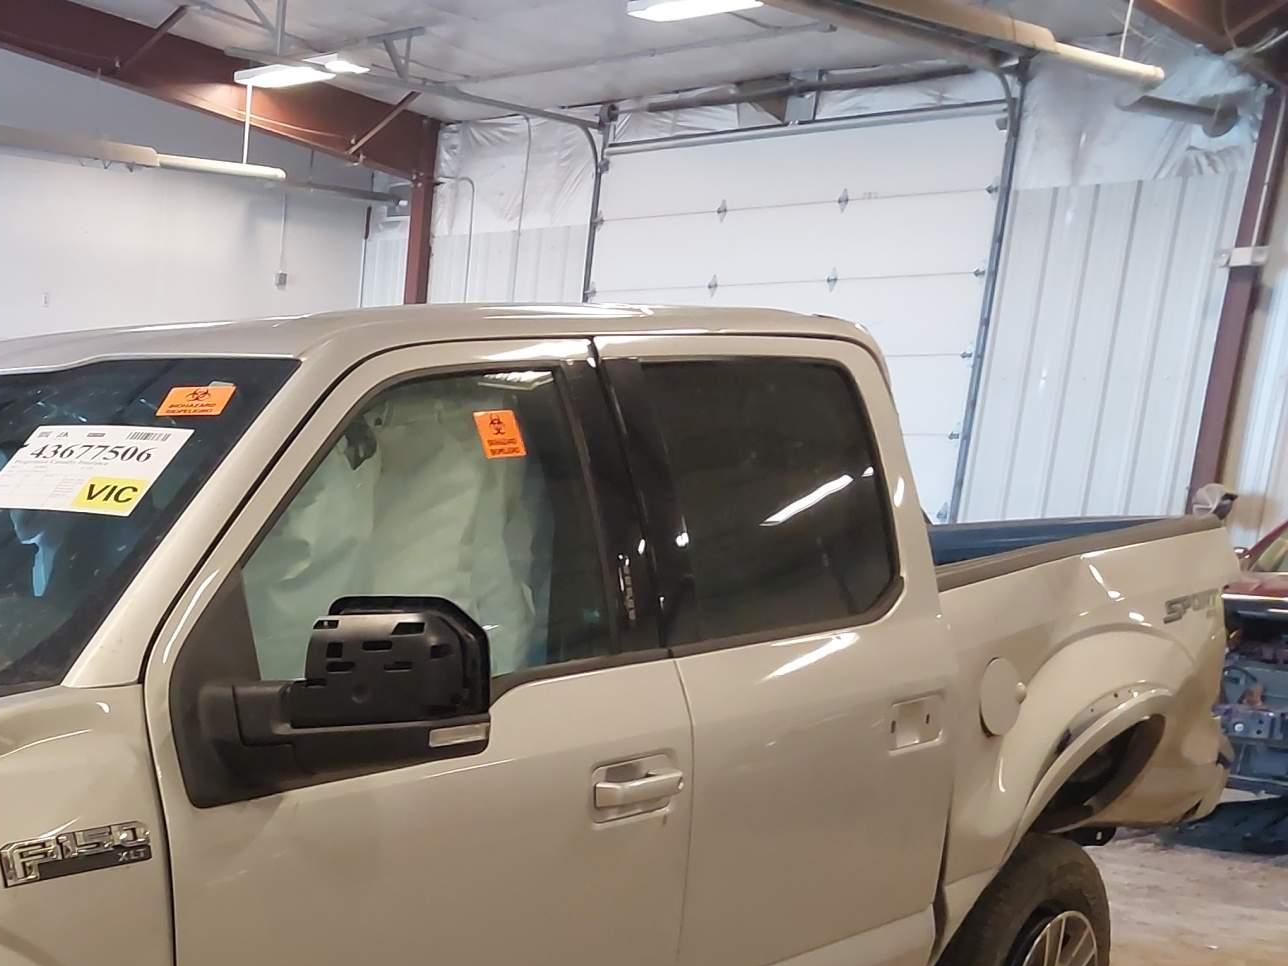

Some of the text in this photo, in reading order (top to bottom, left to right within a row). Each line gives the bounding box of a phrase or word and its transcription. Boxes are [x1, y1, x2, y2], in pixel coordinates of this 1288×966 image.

[29, 443, 156, 462] 43677506
[86, 483, 138, 504] VIC
[117, 847, 147, 862] XLT
